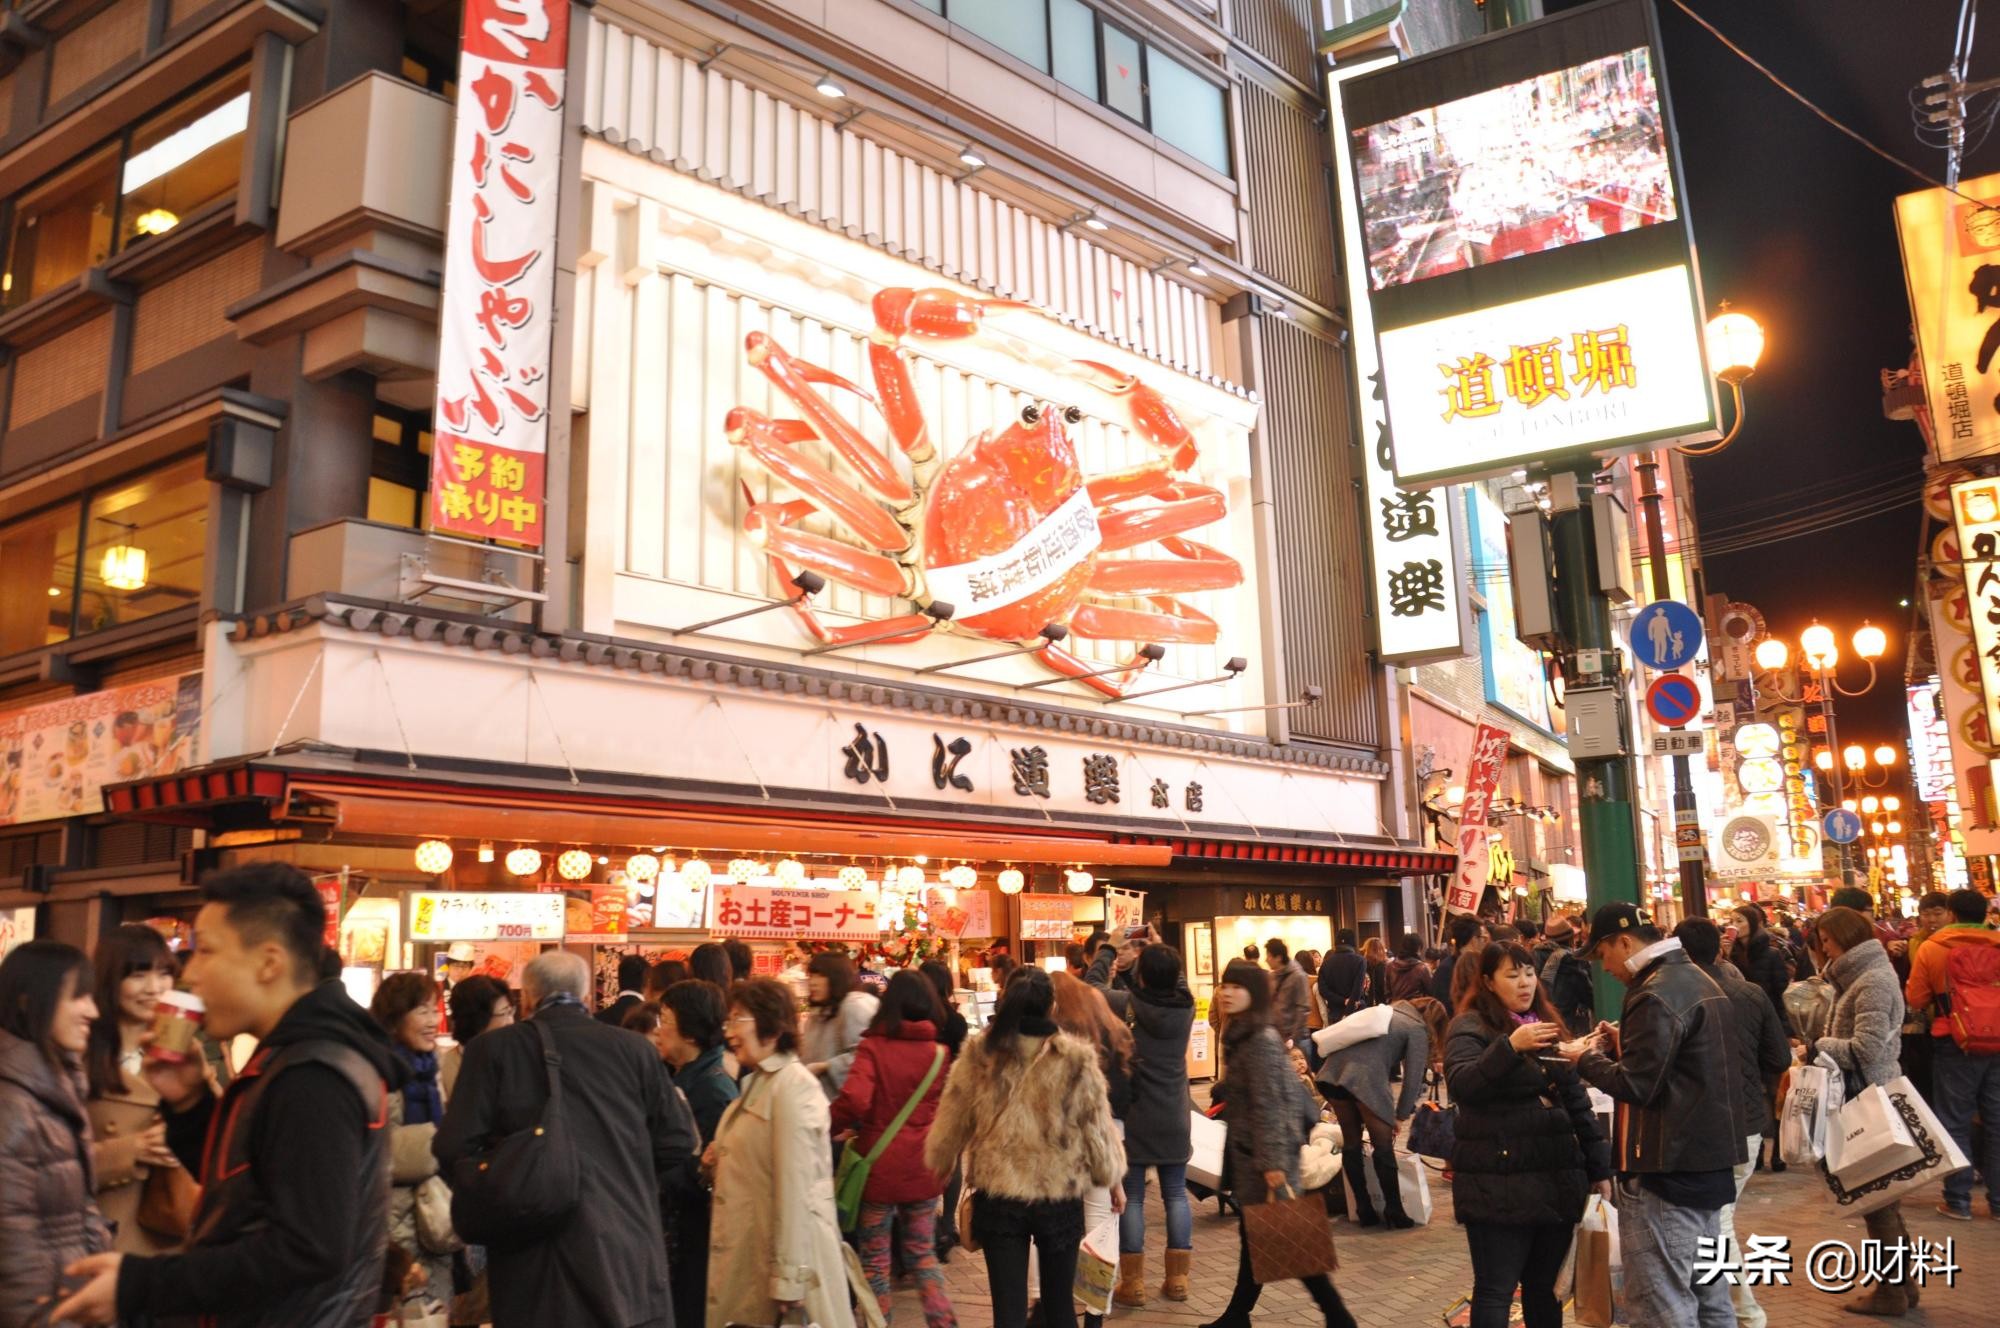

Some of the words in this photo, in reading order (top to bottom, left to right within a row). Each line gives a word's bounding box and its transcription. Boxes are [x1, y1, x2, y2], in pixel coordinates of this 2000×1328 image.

[440, 65, 564, 434] かにしゃぶ
[1438, 323, 1638, 424] 道頓堀
[1943, 361, 1975, 440] 道頓堀店
[451, 444, 527, 491] 予約
[439, 481, 538, 532] 承り中
[1654, 735, 1701, 751] 自動車
[1719, 867, 1748, 877] CAFE
[718, 897, 874, 930] お土産コーナー
[770, 889, 810, 898] SOUVENIR
[811, 891, 831, 899] SHOP
[497, 923, 533, 938] 700円
